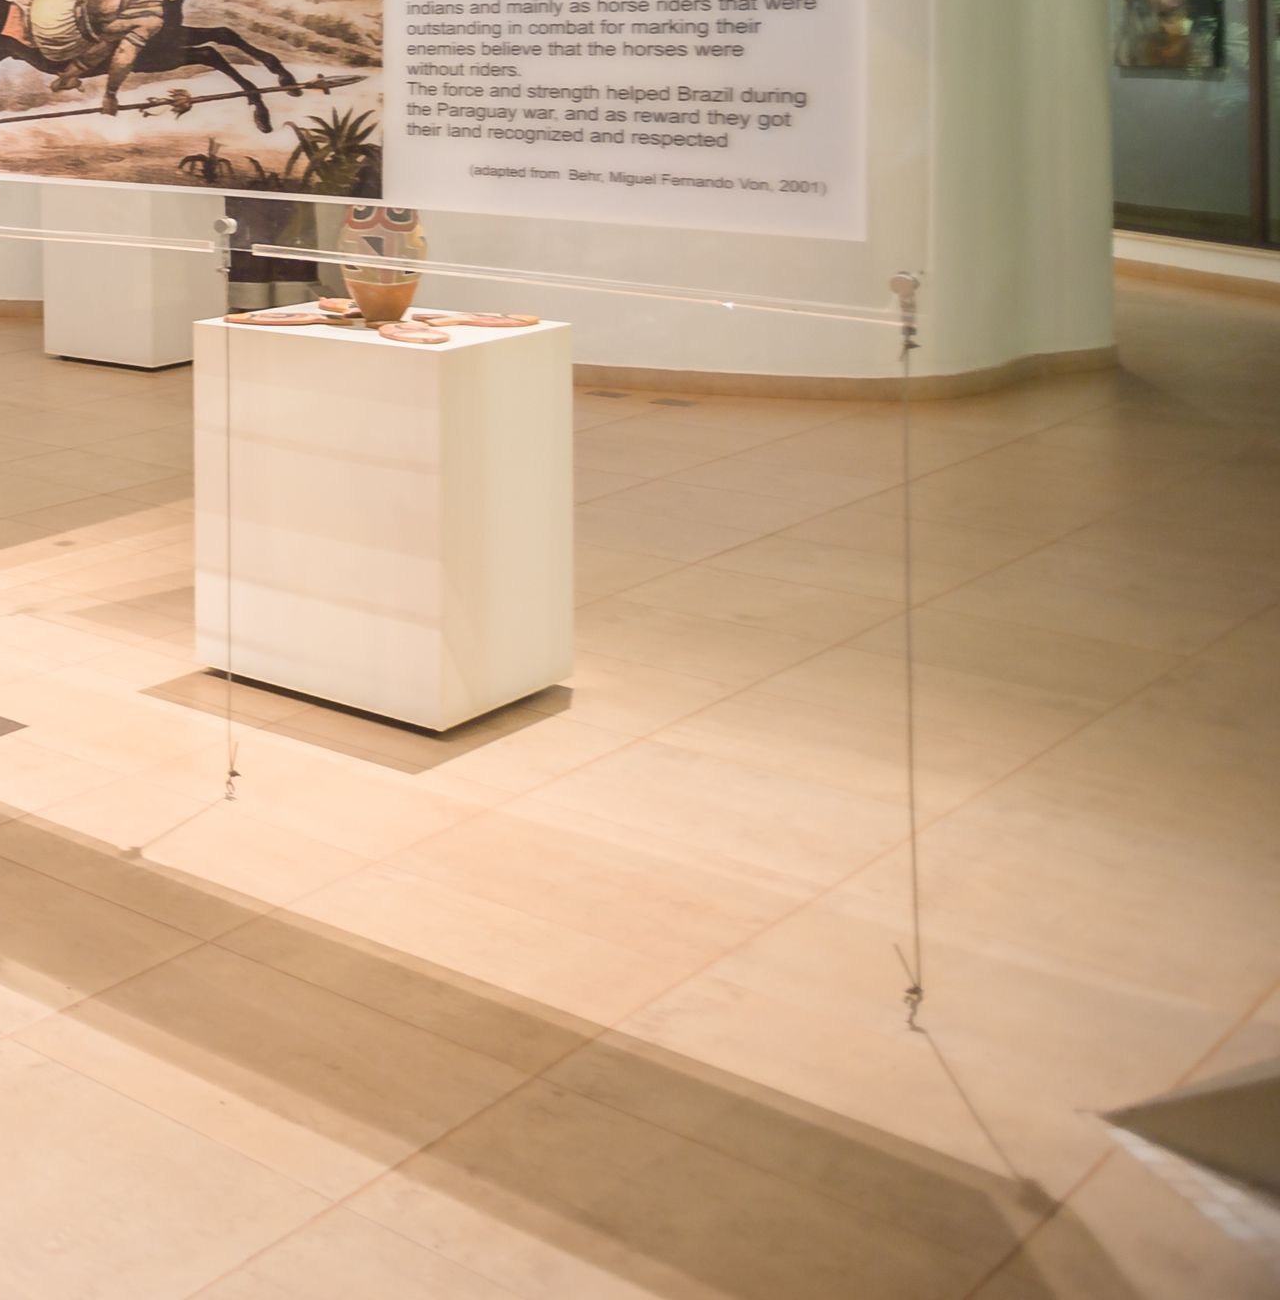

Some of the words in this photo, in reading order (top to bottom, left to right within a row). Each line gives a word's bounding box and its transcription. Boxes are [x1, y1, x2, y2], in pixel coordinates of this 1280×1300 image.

[407, 1, 464, 15] indians
[470, 0, 501, 14] and
[507, 0, 563, 17] mainly
[569, 2, 591, 13] as
[407, 21, 502, 38] outstanding
[508, 21, 522, 34] in
[528, 19, 595, 35] combat
[600, 19, 625, 34] for
[631, 19, 709, 38] marking
[716, 19, 762, 34] their
[407, 42, 476, 55] enemies
[481, 40, 542, 56] believe
[548, 42, 582, 56] that
[587, 42, 616, 56] the
[623, 42, 688, 56] horses
[694, 45, 744, 57] were
[407, 62, 465, 76] without
[470, 63, 522, 77] riders.
[407, 82, 437, 96] The
[443, 82, 484, 97] force
[489, 84, 521, 98] and
[527, 85, 599, 103] strength
[607, 86, 670, 104] helped
[677, 86, 733, 102] Brazil
[740, 87, 807, 108] during
[407, 102, 431, 116] the
[437, 102, 517, 122] Paraguay
[565, 107, 599, 121] and
[605, 110, 627, 122] as
[634, 109, 700, 124] reward
[707, 110, 751, 129] they
[758, 112, 792, 130] got
[407, 123, 442, 136] their
[447, 124, 482, 138] land
[488, 127, 584, 144] recognized
[590, 130, 624, 144] and
[632, 133, 728, 148] respected
[530, 167, 560, 179] from
[609, 171, 657, 186] Miguel
[661, 173, 734, 189] Fernando
[779, 179, 828, 196] 2001)
